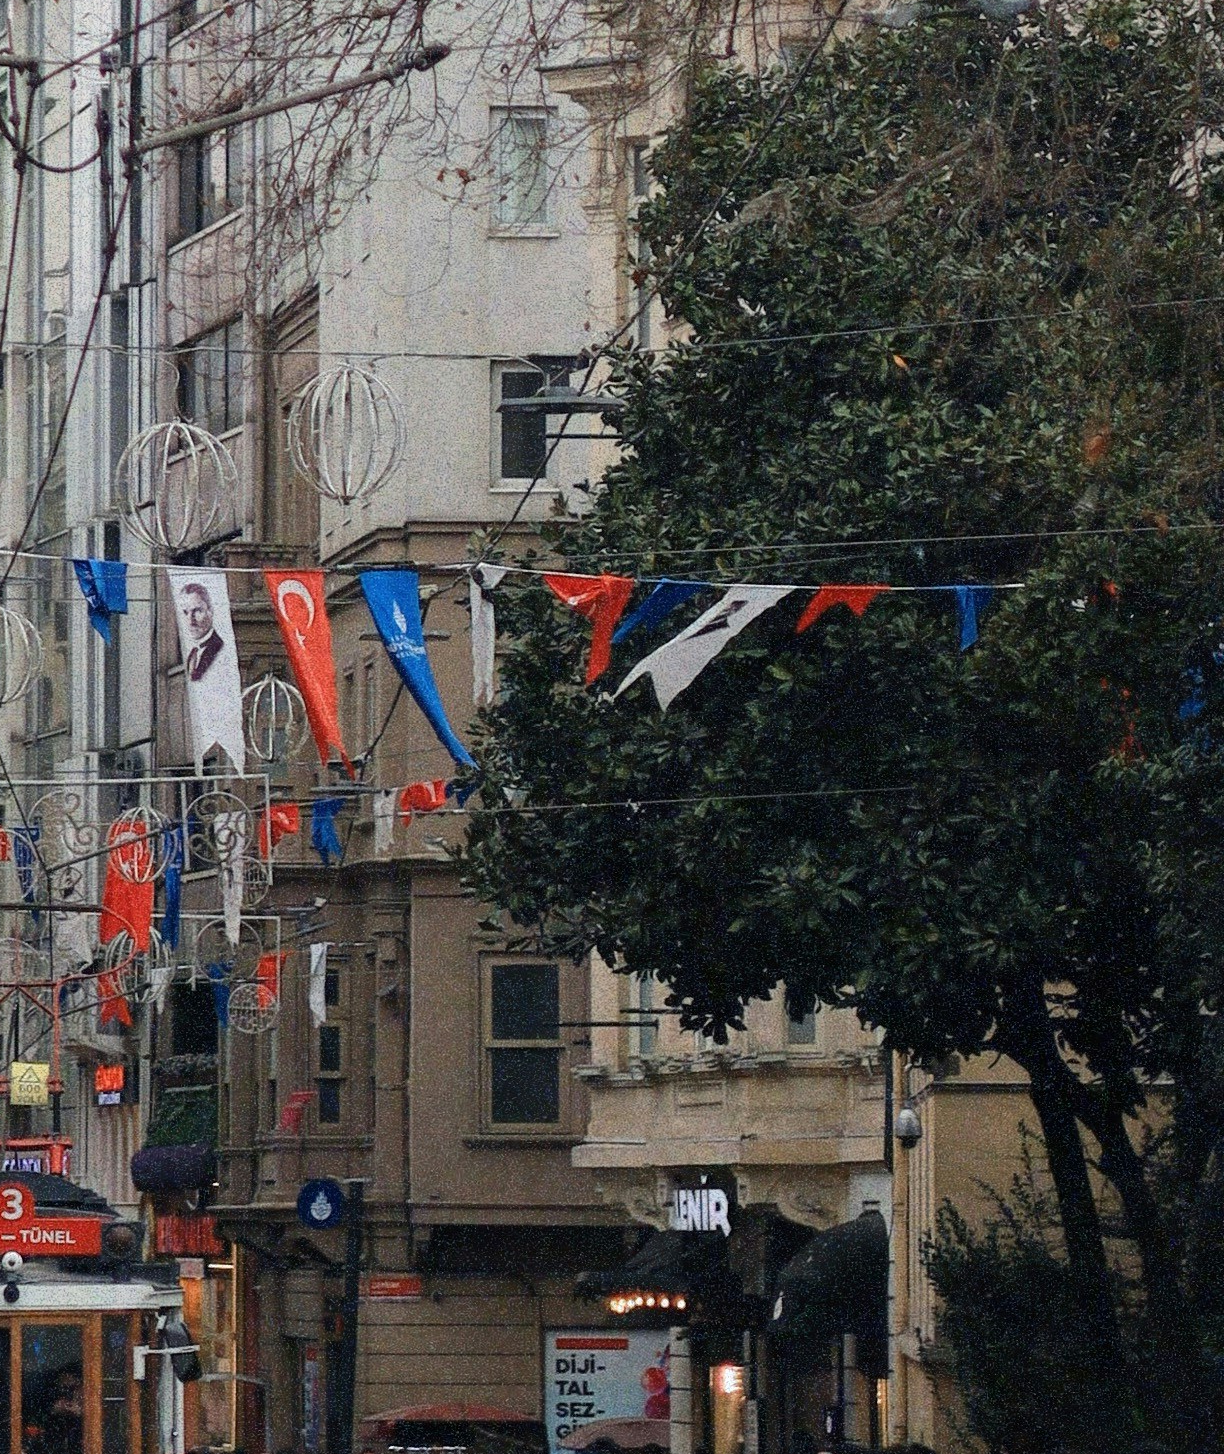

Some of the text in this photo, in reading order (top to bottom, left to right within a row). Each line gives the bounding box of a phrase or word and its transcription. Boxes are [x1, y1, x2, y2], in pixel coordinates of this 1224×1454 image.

[19, 1084, 41, 1094] 600
[1, 1188, 24, 1220] 3
[19, 1227, 76, 1244] TÜNEL
[556, 1353, 606, 1375] DİJİ-
[555, 1380, 594, 1395] TAL
[556, 1402, 606, 1418] SEZ-
